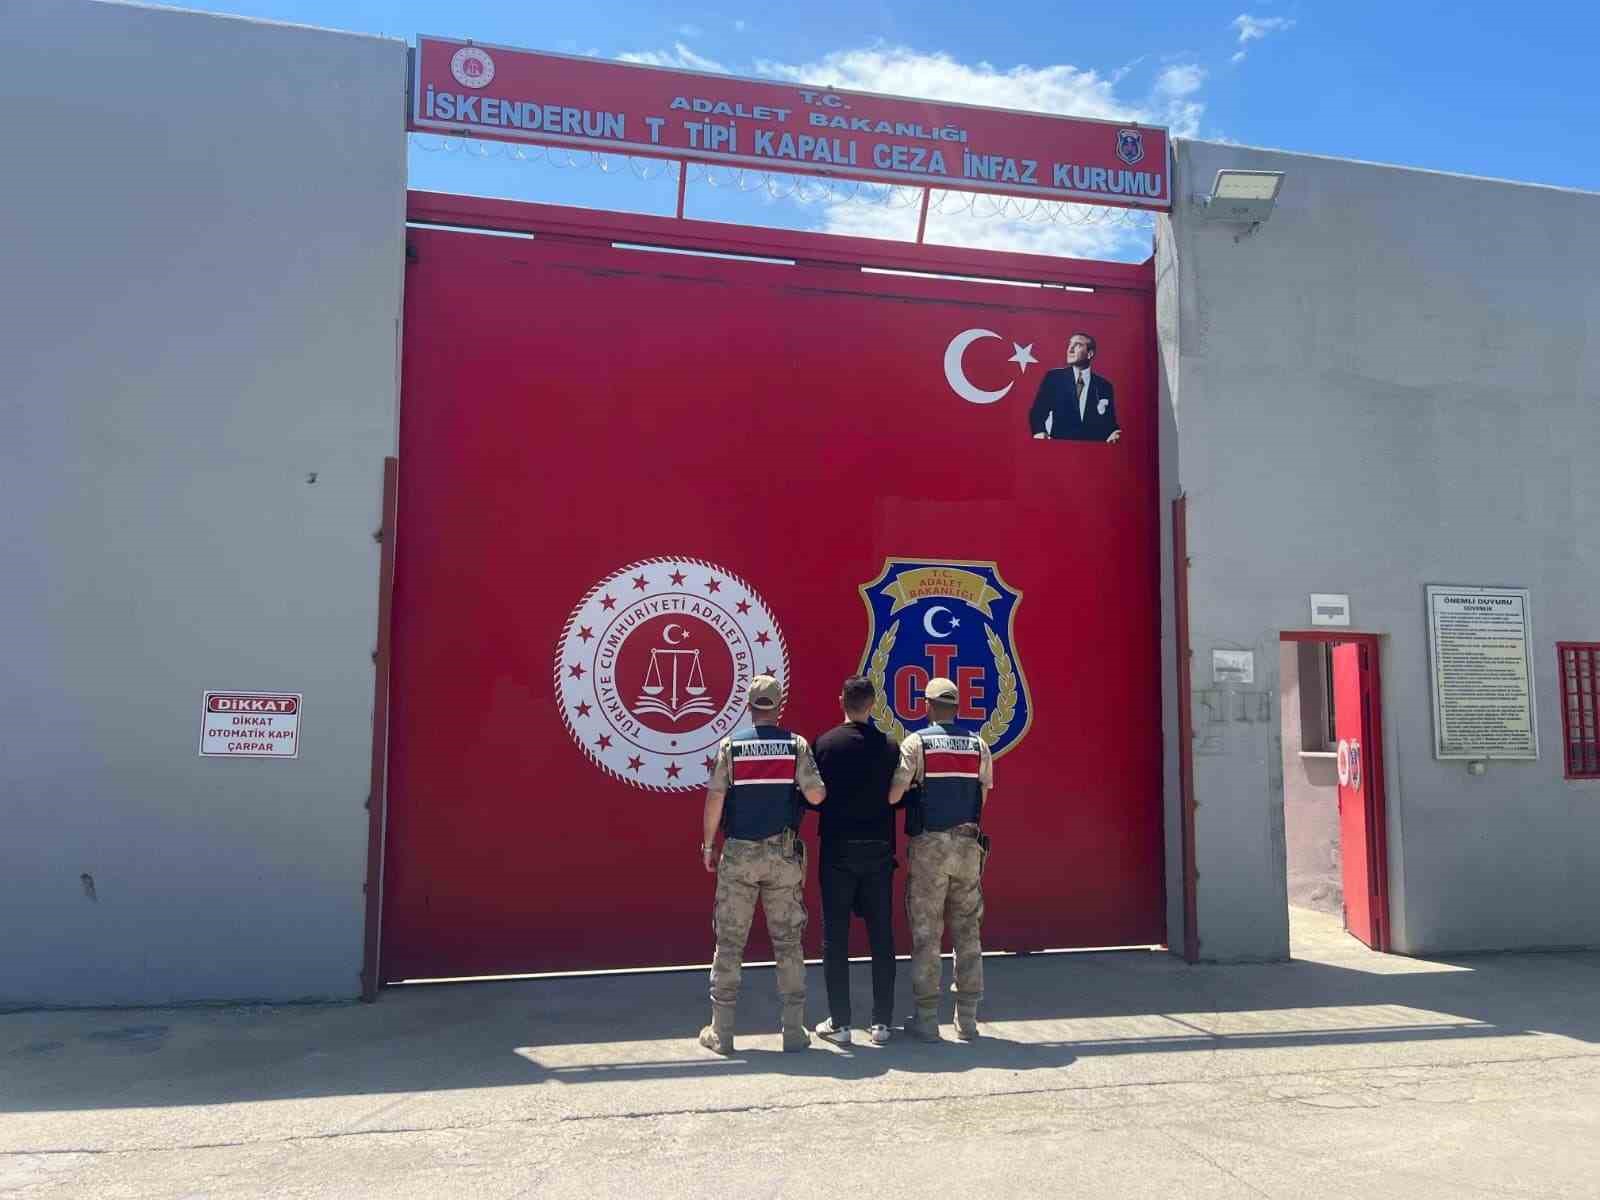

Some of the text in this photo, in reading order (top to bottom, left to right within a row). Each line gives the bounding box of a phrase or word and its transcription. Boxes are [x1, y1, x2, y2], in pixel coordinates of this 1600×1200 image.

[799, 90, 851, 109] T.C.
[670, 96, 967, 142] ADALET BAKANLIĞI
[426, 84, 1162, 198] İSKENDERUN T TİPİ KAPALI CEZA İNFAZ KURUMU
[919, 577, 963, 588] ADALET
[691, 602, 741, 646] ADALET
[601, 597, 686, 669] CUMHURİYETİ
[711, 651, 748, 734] BAKANLIĞI
[218, 699, 289, 711] DİKKAT
[232, 716, 273, 725] DİKKAT
[208, 728, 294, 739] OTOMATİK KAPI
[227, 742, 274, 753] ÇARPAR
[738, 743, 790, 757] JANDARMA
